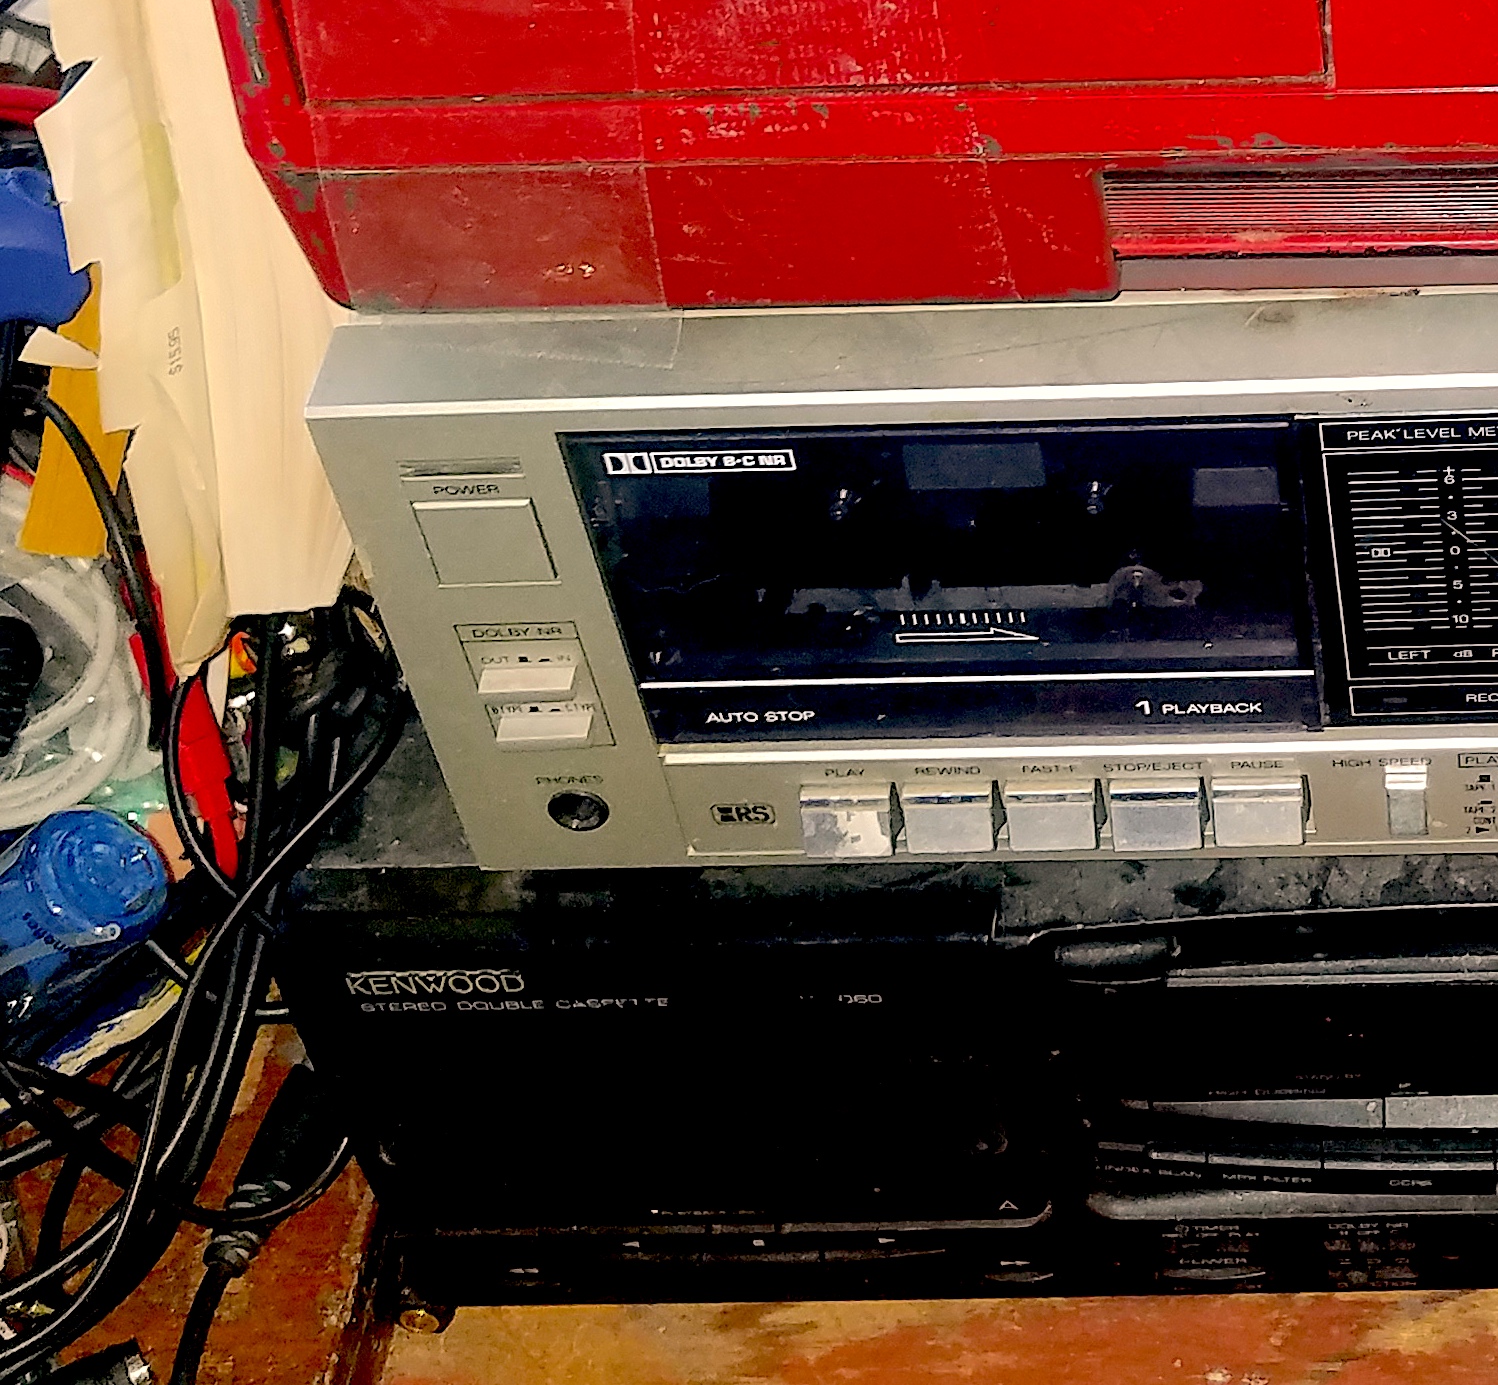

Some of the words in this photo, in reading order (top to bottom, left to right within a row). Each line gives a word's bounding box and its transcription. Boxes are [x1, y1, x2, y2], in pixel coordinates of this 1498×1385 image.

[1346, 428, 1397, 441] PEAK
[1403, 427, 1461, 439] LEVEL
[660, 456, 718, 468] DOLBY
[433, 484, 500, 495] POWER
[1447, 510, 1458, 521] 3
[1450, 545, 1461, 556] 0
[1453, 579, 1463, 590] 5
[1452, 613, 1469, 623] 10
[472, 627, 530, 639] DOLBY
[1387, 649, 1431, 660] LEFT
[1135, 699, 1152, 715] 1
[1161, 700, 1263, 715] PLAYBACK
[705, 711, 759, 723] AUTO
[764, 710, 817, 722] STOP
[1102, 760, 1204, 773] STOP/EJECT
[1231, 759, 1285, 770] PAUSE
[1332, 758, 1371, 768] HIGH
[1378, 756, 1432, 767] SPEED
[825, 767, 865, 778] PLAY
[914, 765, 981, 776] REWIND
[535, 775, 604, 787] PHONES
[346, 973, 526, 995] KENWOOD
[361, 1000, 448, 1012] STEREO
[457, 999, 545, 1011] DOUBLE
